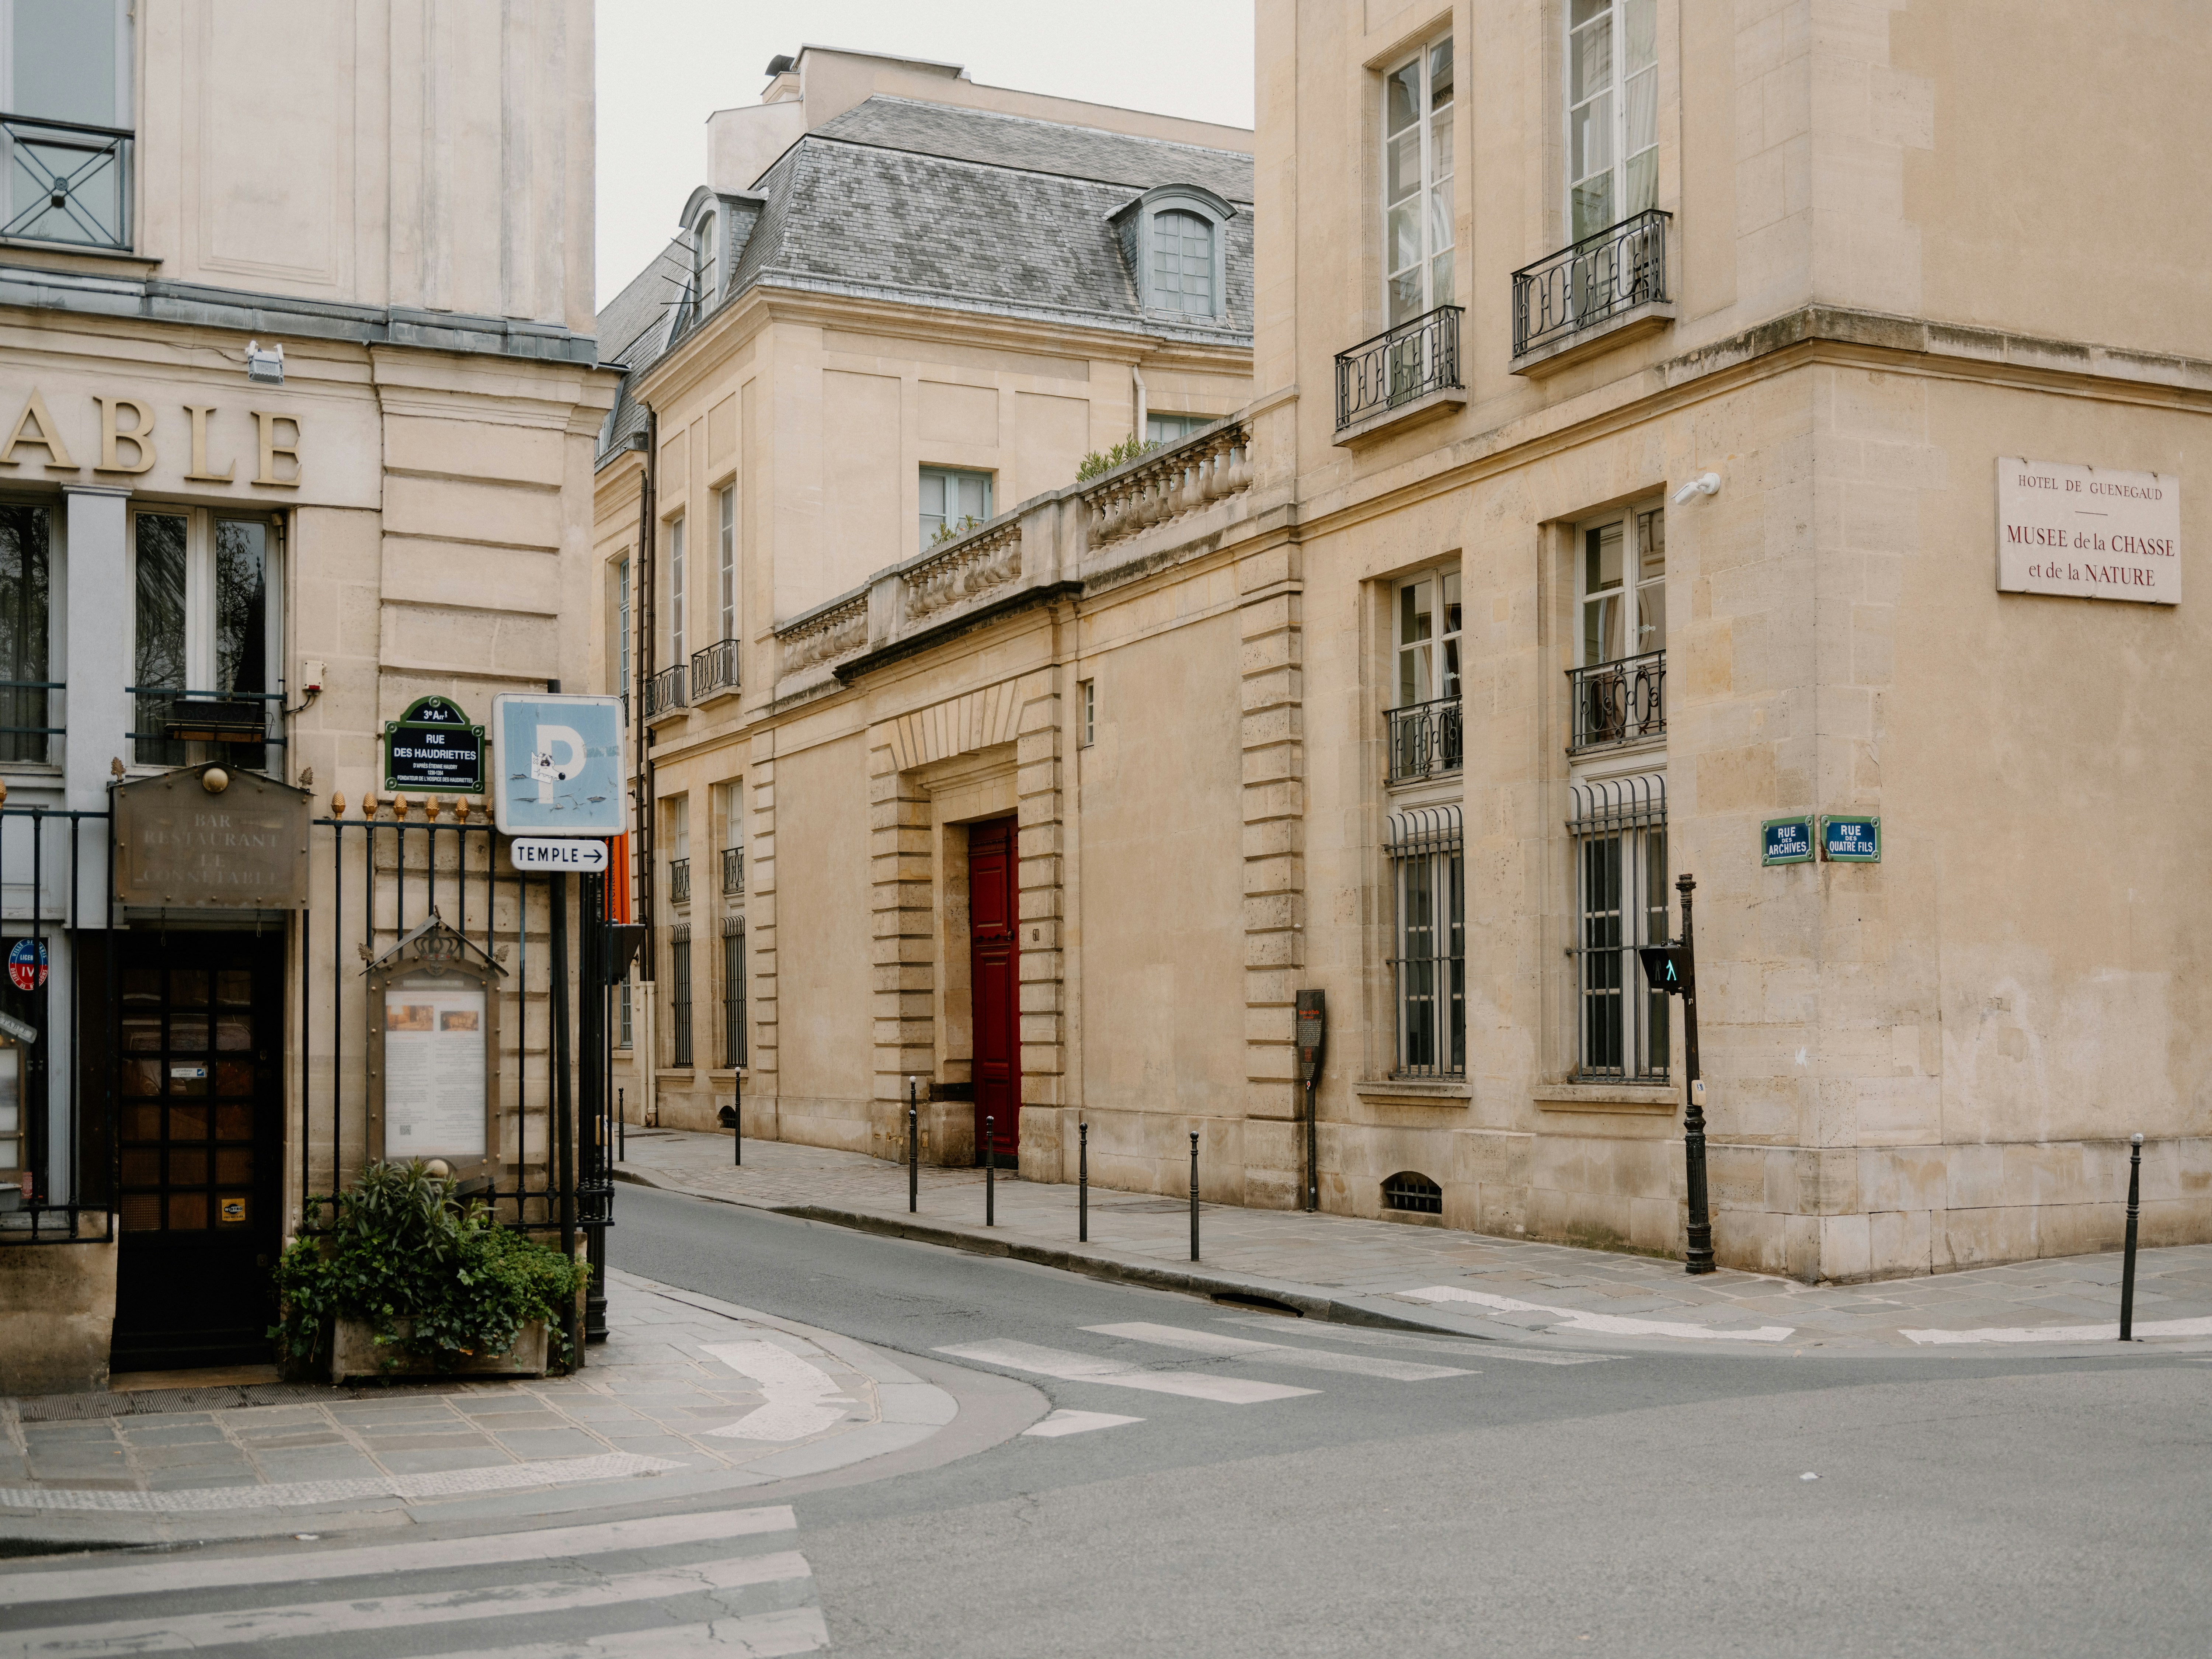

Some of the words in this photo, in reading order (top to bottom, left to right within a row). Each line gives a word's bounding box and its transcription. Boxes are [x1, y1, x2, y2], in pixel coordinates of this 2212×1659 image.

[2018, 475, 2058, 490] HOTEL
[2065, 480, 2081, 492] DE
[2090, 482, 2162, 500] GUENEGAUD
[2007, 525, 2067, 547] MUSEE
[2074, 532, 2090, 549] de
[2094, 533, 2105, 551] la
[2112, 535, 2175, 556] CHASSE
[2029, 563, 2041, 577] et
[2046, 562, 2062, 579] de
[2068, 563, 2079, 580] la
[2085, 564, 2155, 587] NATURE
[426, 734, 445, 744] RUE
[394, 748, 413, 758] DES
[414, 748, 476, 760] HAUDRIETTES
[536, 725, 587, 804] P
[195, 814, 231, 828] BAR
[1778, 827, 1796, 838] RUE
[1841, 825, 1861, 835] RUE
[144, 830, 279, 848] RESTAURANT
[1769, 841, 1806, 855] ARCHIVES
[1829, 841, 1855, 852] QUATRE
[1858, 842, 1873, 852] FILS
[518, 846, 578, 863] TEMPLE
[1033, 929, 1039, 941] 60
[12, 942, 24, 956] VILLE
